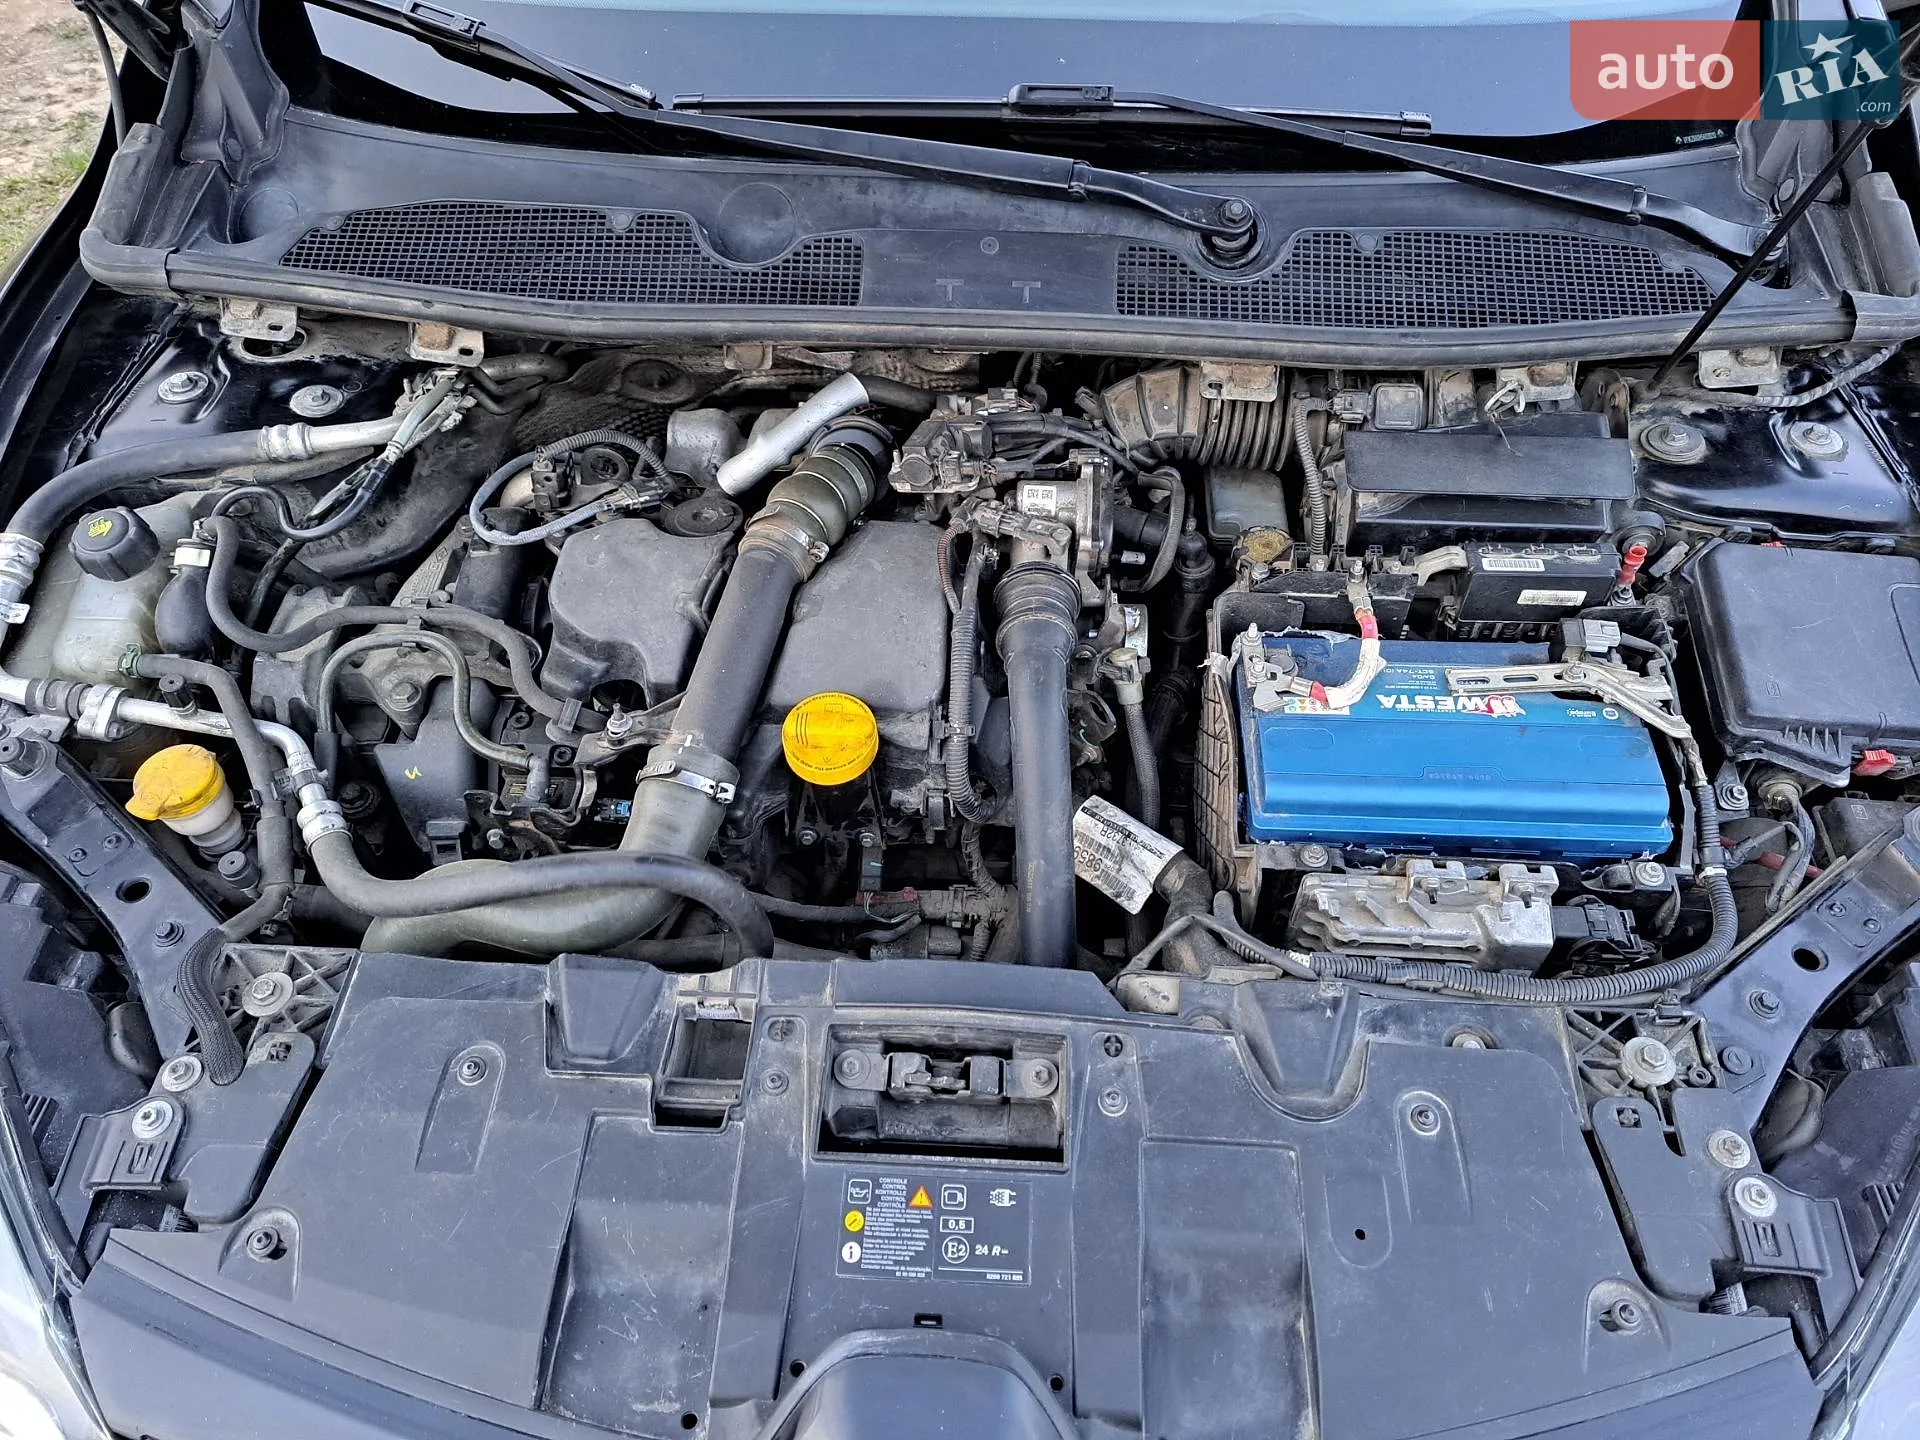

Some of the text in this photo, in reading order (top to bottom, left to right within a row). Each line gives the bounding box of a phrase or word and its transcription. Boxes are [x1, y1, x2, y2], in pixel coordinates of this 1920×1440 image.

[1376, 694, 1485, 711] WESTA
[948, 1219, 966, 1230] 0,5
[947, 1241, 966, 1258] E2
[975, 1244, 988, 1255] 24
